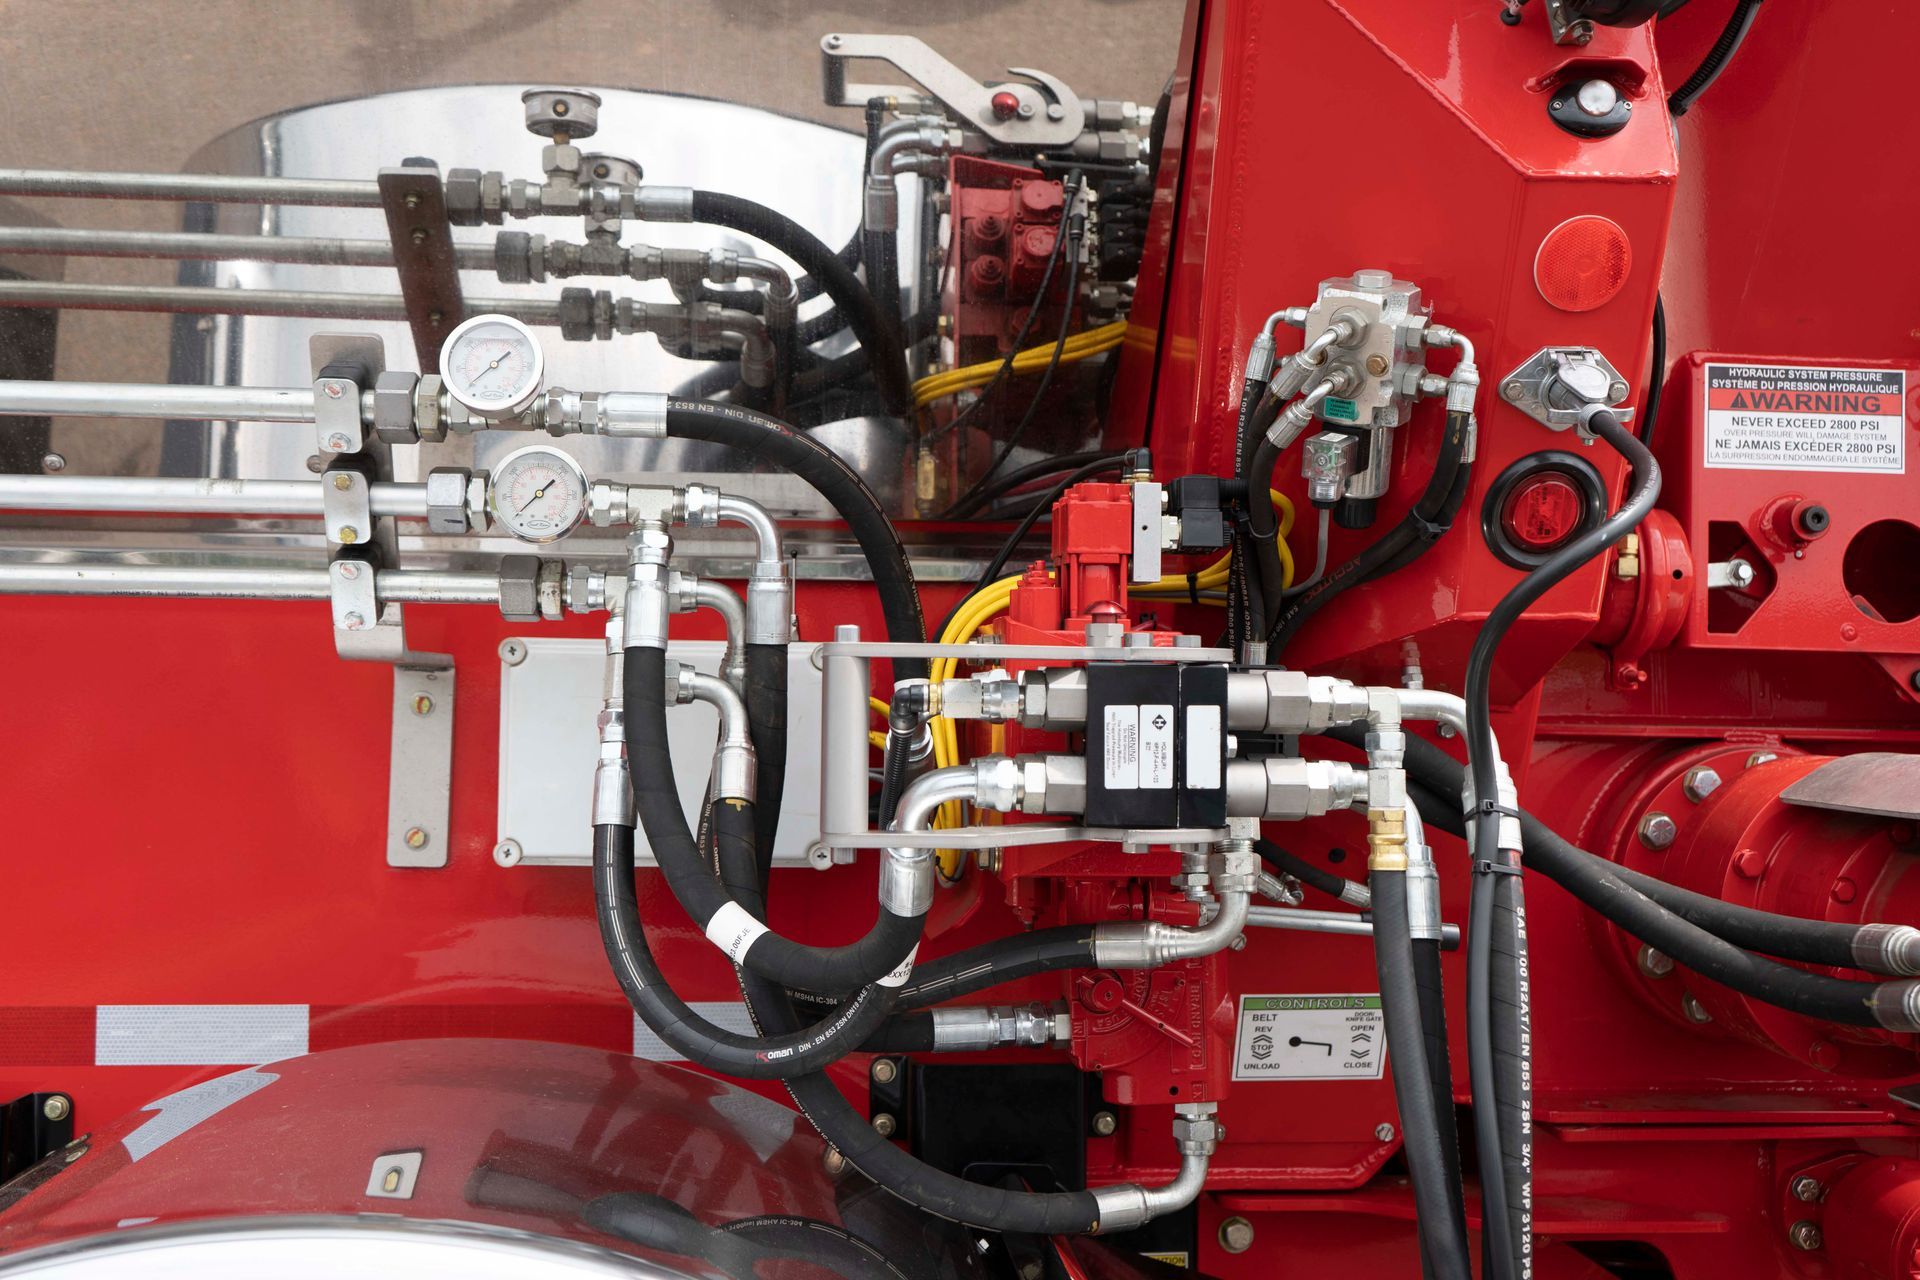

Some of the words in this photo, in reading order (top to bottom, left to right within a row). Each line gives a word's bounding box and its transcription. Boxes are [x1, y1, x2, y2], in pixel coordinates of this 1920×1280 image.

[1729, 368, 1785, 378] HYDRAULIC
[1788, 370, 1827, 380] SYSTEM
[1830, 371, 1882, 381] PRESSURE
[1761, 380, 1775, 390] DU
[1777, 381, 1827, 391] PRESSION
[1829, 383, 1899, 394] HYDRAULIQUE
[675, 401, 695, 411] 853
[698, 403, 714, 413] EN
[1750, 392, 1880, 412] WARNING
[724, 408, 744, 419] DIN
[1732, 416, 1773, 427] NEVER
[1777, 418, 1826, 429] EXCEED
[1830, 420, 1856, 430] 2800
[1860, 421, 1879, 430] PSI
[1724, 428, 1747, 436] OVER
[1749, 429, 1794, 438] PRESSURE
[1796, 431, 1813, 439] WILL
[1816, 432, 1852, 440] DAMAGE
[1854, 433, 1887, 441] SYSTEM
[1715, 439, 1732, 449] NE
[1735, 440, 1780, 450] JAMAIS
[1846, 443, 1873, 453] 2800
[1877, 444, 1896, 454] PSI
[1722, 452, 1781, 461] SURPRESSION
[1783, 453, 1848, 463] ENDOMMAGERA
[1850, 455, 1860, 463] LE
[1516, 906, 1527, 939] SAE
[1519, 949, 1528, 977] 100
[1190, 985, 1201, 1028] BRAND
[1266, 998, 1366, 1009] CONTROLS
[798, 1042, 812, 1053] DIN
[815, 1034, 826, 1046] EN
[825, 1026, 837, 1039] 853
[835, 1015, 848, 1031] 2SN
[858, 987, 869, 1004] SAE
[1520, 980, 1530, 1057] R2AT/EN
[1521, 1061, 1531, 1091] 853
[1521, 1100, 1531, 1134] 2SN
[1522, 1182, 1531, 1209] WP
[1522, 1214, 1531, 1253] 3120
